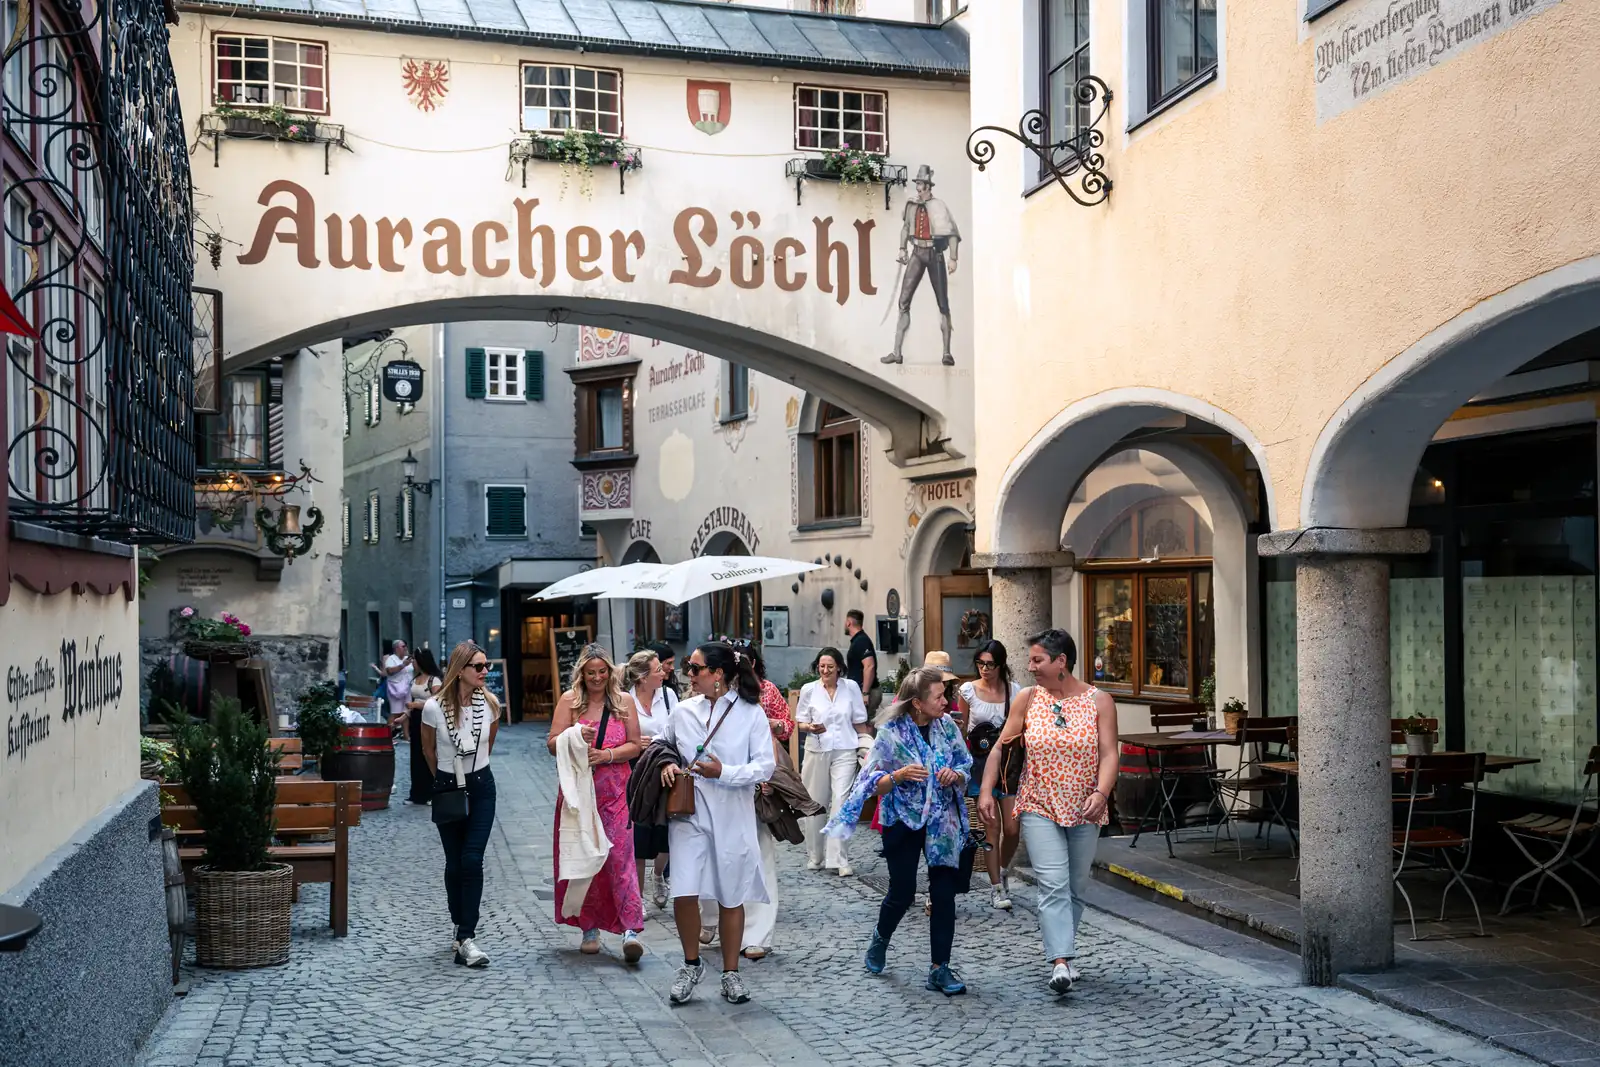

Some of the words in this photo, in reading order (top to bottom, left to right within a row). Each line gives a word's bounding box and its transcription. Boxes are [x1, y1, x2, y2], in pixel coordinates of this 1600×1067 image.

[1428, 2, 1501, 67] Brunnen
[236, 179, 646, 289] Auracher
[668, 206, 878, 306] Löchl
[649, 357, 683, 393] Auracher
[927, 481, 962, 500] HOTEL
[690, 506, 760, 559] RESTAURANT
[711, 566, 768, 581] Dallmayr
[60, 634, 122, 726] Weinhaus
